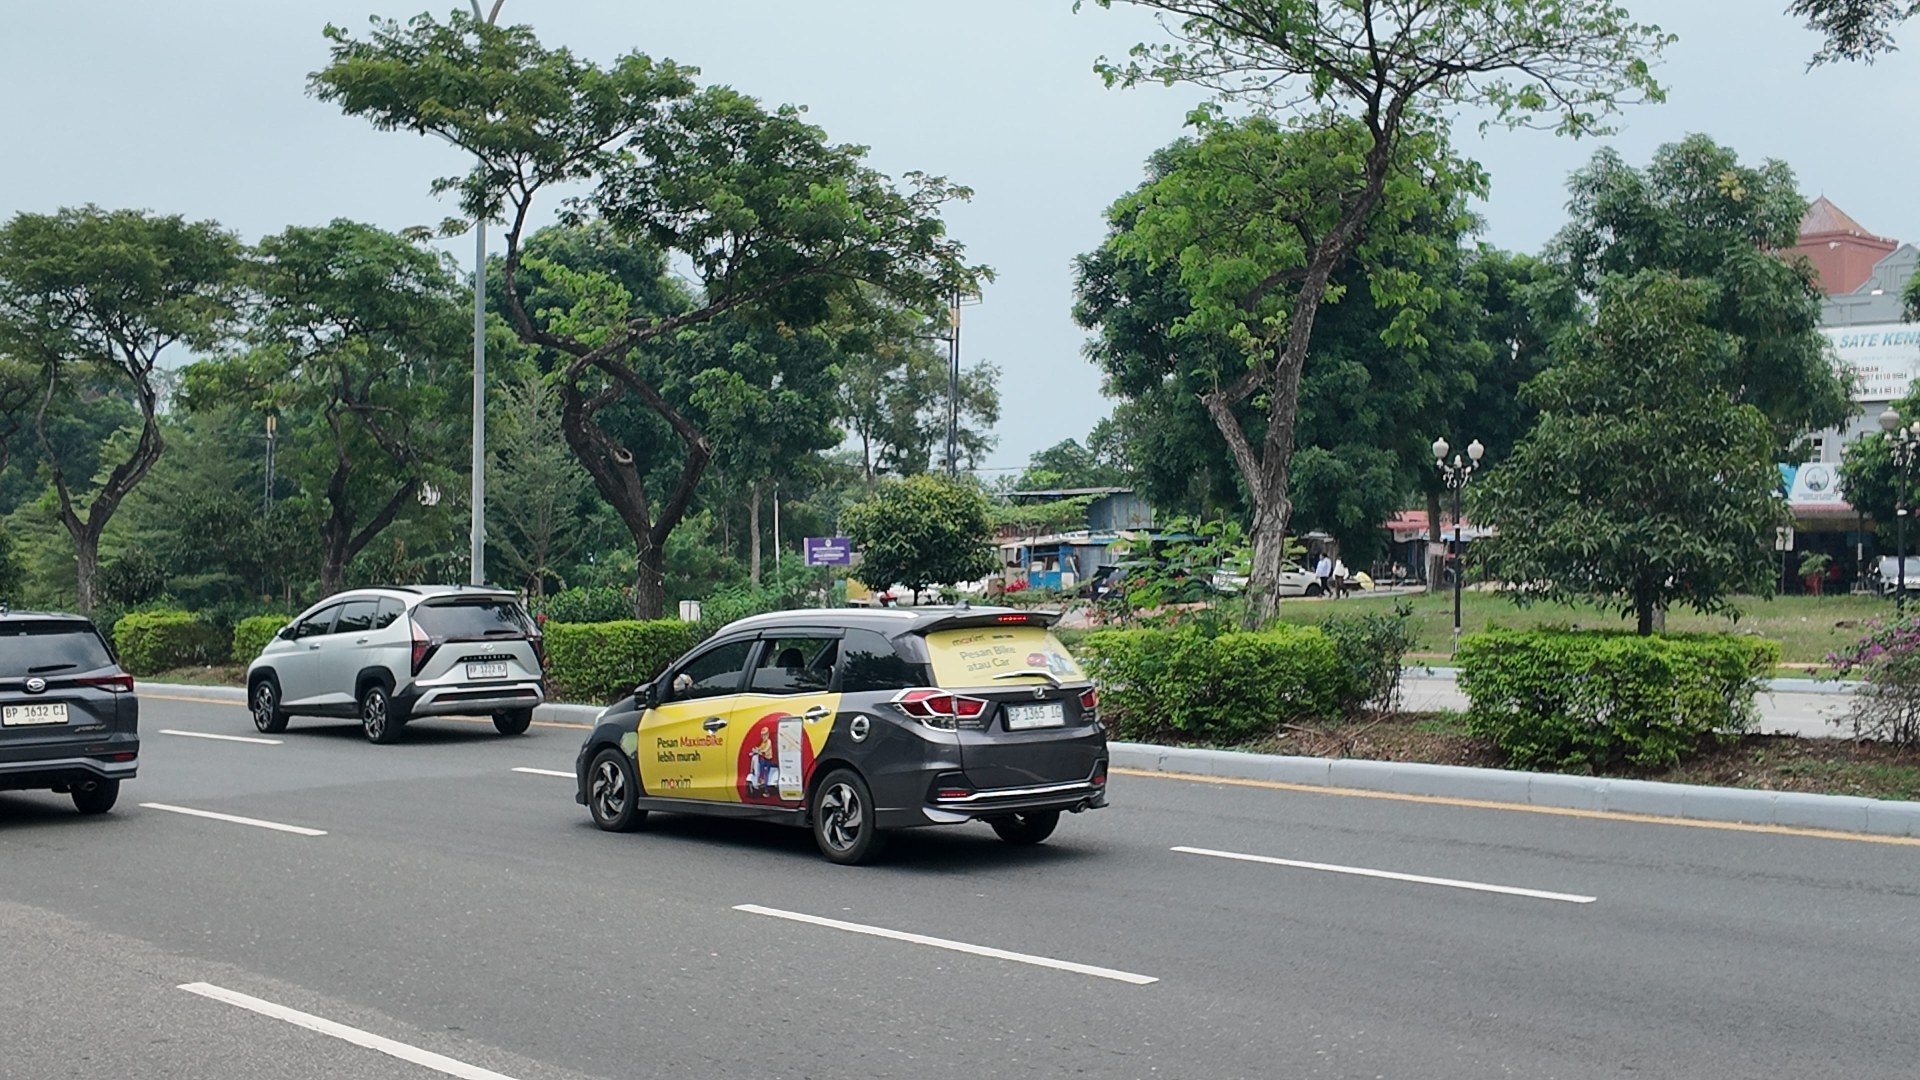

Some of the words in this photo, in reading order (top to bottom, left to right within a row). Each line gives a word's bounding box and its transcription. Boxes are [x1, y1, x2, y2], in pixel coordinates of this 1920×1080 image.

[1839, 333, 1879, 348] SATE
[960, 649, 993, 660] Pesan
[967, 661, 991, 671] atau
[992, 657, 1010, 667] Car
[5, 707, 18, 718] BP
[657, 737, 679, 749] Pesan
[680, 735, 724, 748] MaximBike
[657, 751, 676, 763] lebih
[677, 750, 702, 761] murah
[660, 774, 693, 790] maxim
